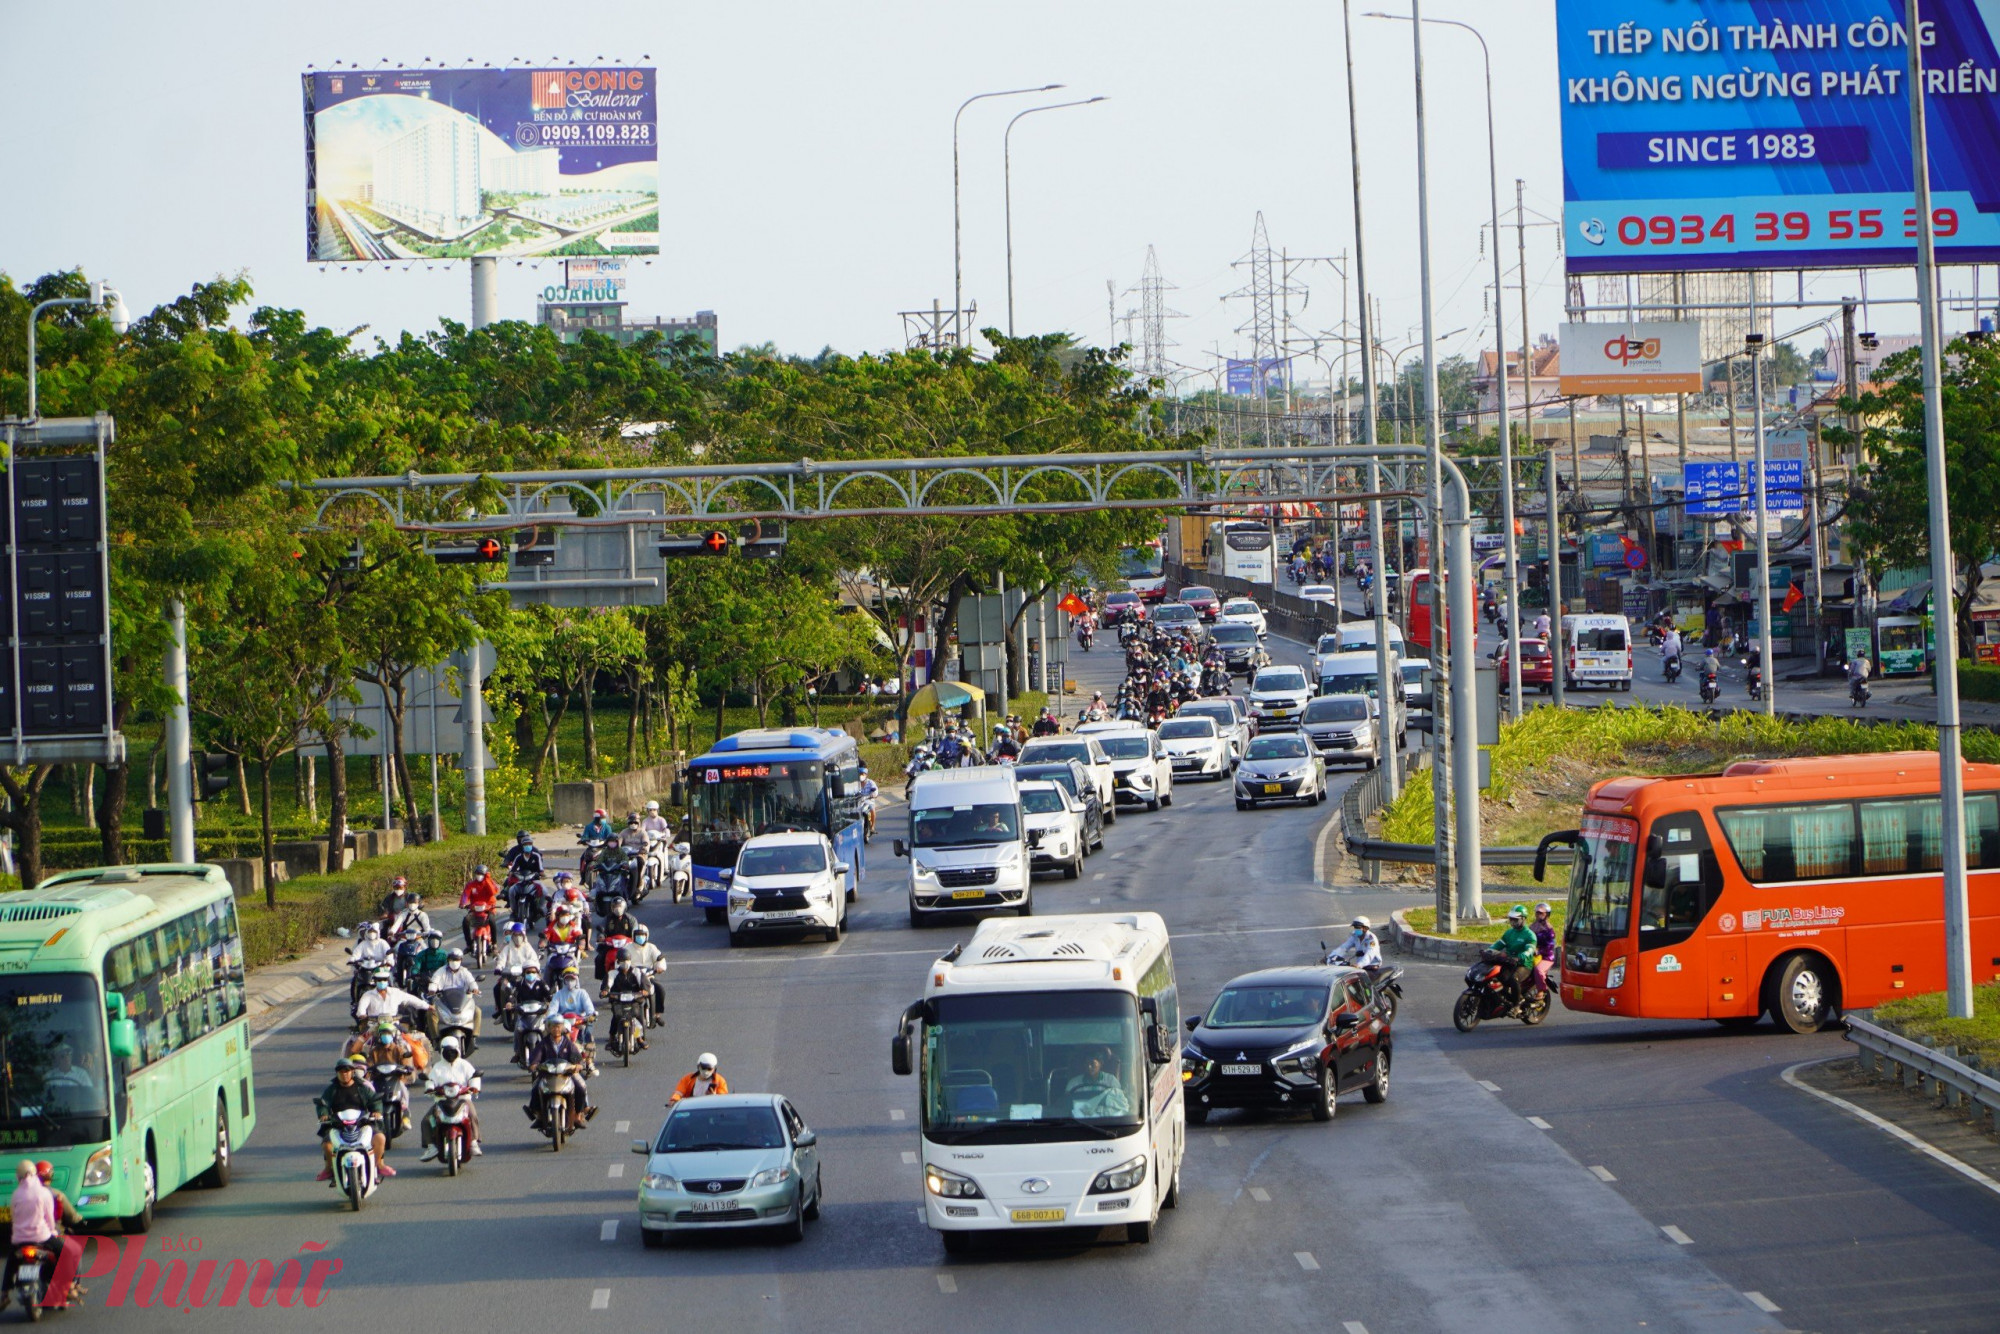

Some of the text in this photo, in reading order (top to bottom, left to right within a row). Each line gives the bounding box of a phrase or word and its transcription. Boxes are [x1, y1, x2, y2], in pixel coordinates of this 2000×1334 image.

[1587, 15, 1936, 54] TIẾP NỐI THÀNH CÔNG
[566, 71, 644, 91] CONIC
[1567, 71, 1681, 103] KHÔNG
[1691, 66, 1811, 99] NGỪNG
[1821, 65, 1901, 96] PHÁT
[566, 90, 644, 108] Boulevar
[533, 110, 553, 121] BẾN
[570, 112, 583, 120] AN
[584, 111, 598, 120] CƯ
[599, 111, 626, 120] HOÀN
[542, 125, 650, 140] 0909.109.828
[1648, 134, 1816, 163] SINCE 1983
[1617, 208, 1959, 245] 0934 39 55 39
[22, 500, 48, 508] VISSEM
[62, 498, 88, 506] VISSEM
[1767, 499, 1782, 508] QUY
[1783, 499, 1801, 509] ĐỊNH
[24, 592, 50, 600] VISSEM
[65, 591, 91, 599] VISSEM
[27, 685, 53, 693] VISSEM
[68, 683, 94, 692] VISSEM
[707, 771, 718, 781] 84
[1762, 905, 1845, 921] FUTA Bus Lines
[1664, 956, 1673, 964] 37
[951, 1152, 984, 1160] THACO
[1087, 1147, 1114, 1155] OWN
[1015, 1210, 1060, 1220] 66B-007.11
